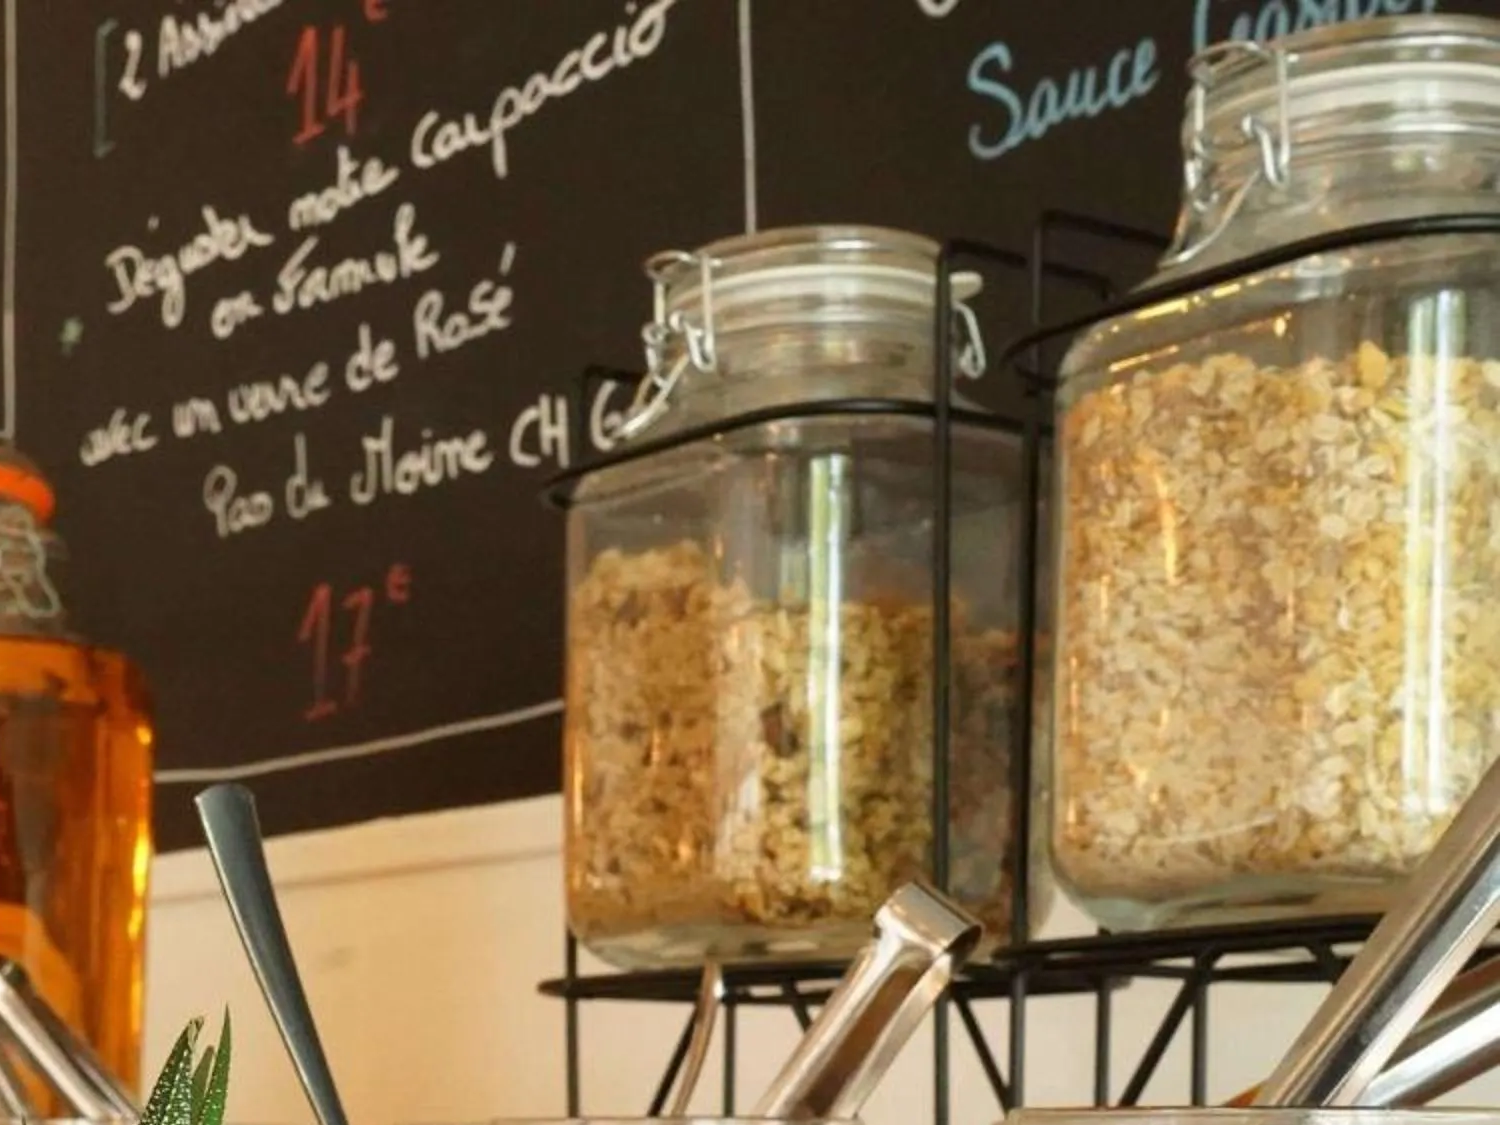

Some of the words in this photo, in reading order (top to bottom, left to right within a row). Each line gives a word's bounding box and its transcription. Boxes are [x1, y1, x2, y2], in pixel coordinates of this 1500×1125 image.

[967, 37, 1160, 160] Sauce
[172, 397, 222, 439] un
[345, 322, 400, 392] de
[413, 242, 514, 358] Rosé
